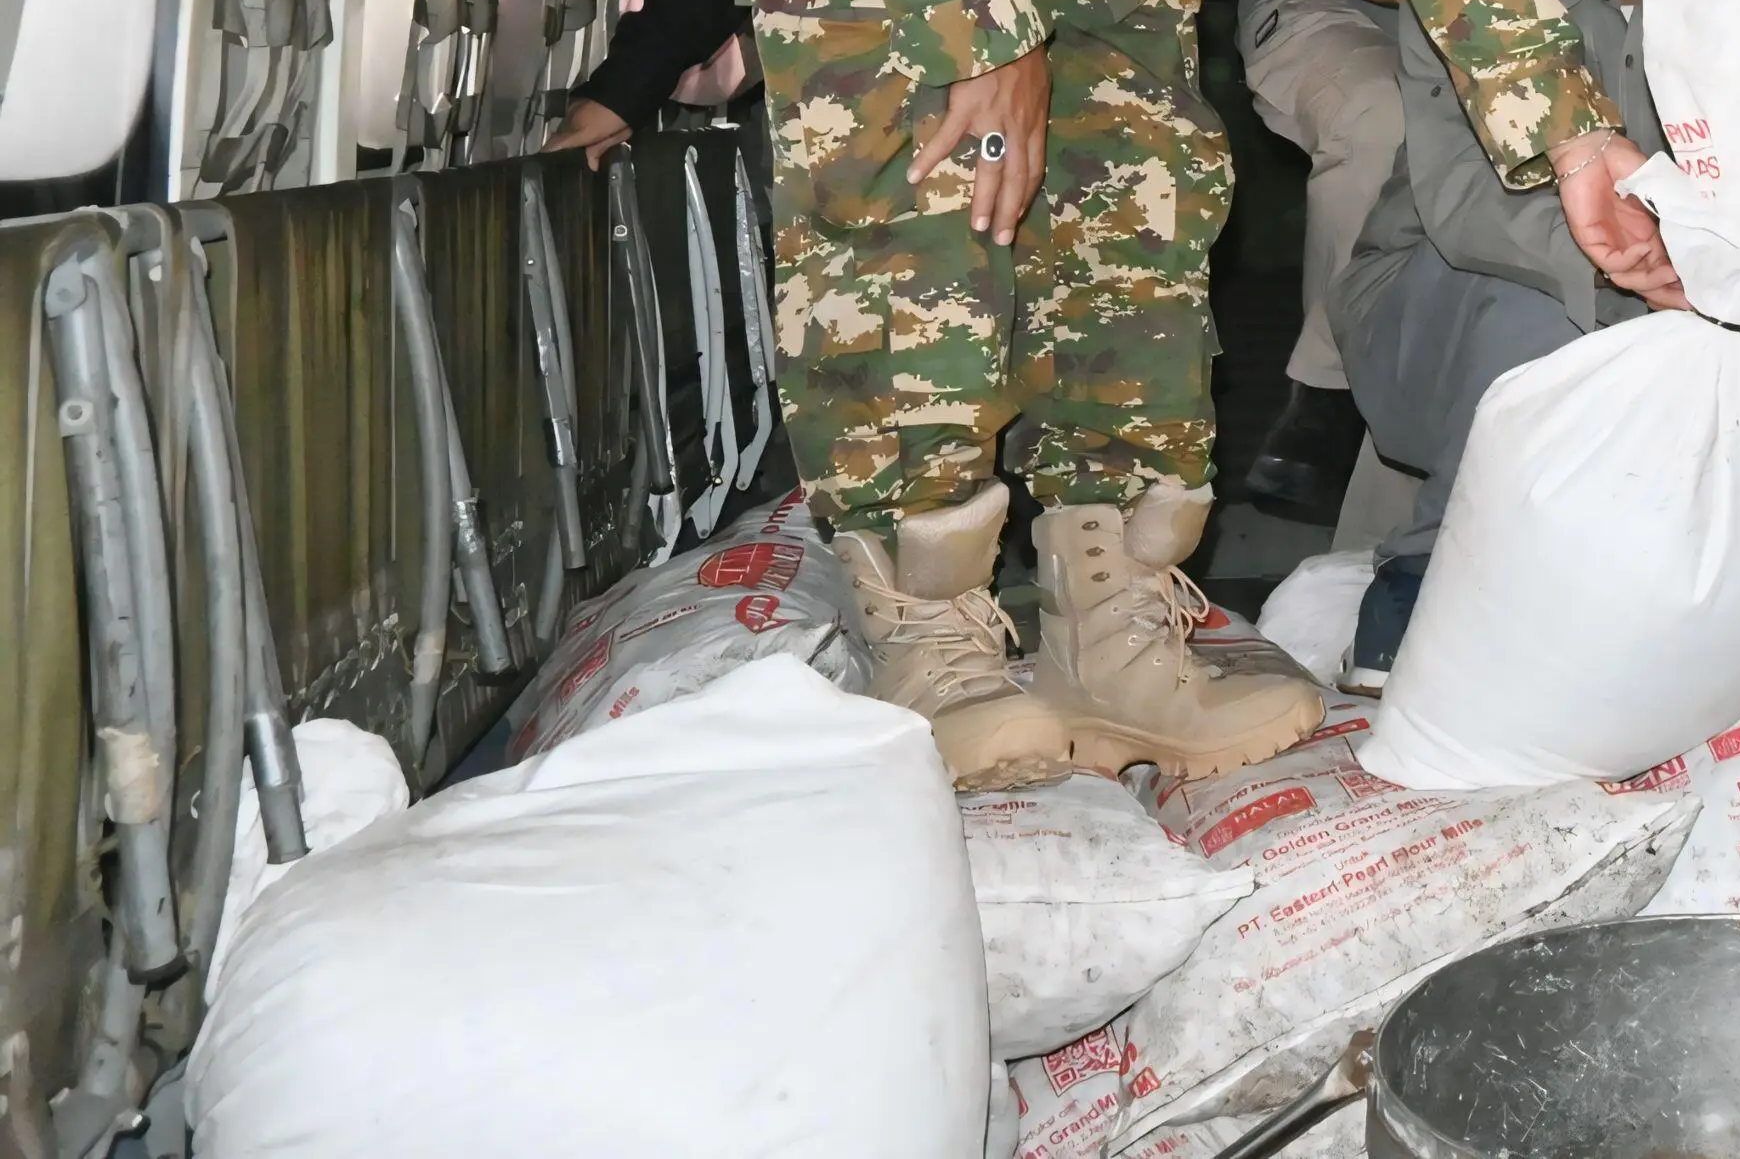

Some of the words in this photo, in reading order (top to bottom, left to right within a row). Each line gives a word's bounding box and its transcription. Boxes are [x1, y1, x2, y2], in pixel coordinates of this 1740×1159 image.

[1262, 830, 1330, 861] Golden
[1335, 807, 1393, 832] Grand
[1237, 915, 1268, 939] PT.
[1270, 881, 1339, 923] Eastern
[1342, 856, 1390, 889] Pearl
[1392, 835, 1438, 861] Flour
[1049, 1102, 1100, 1145] Grand
